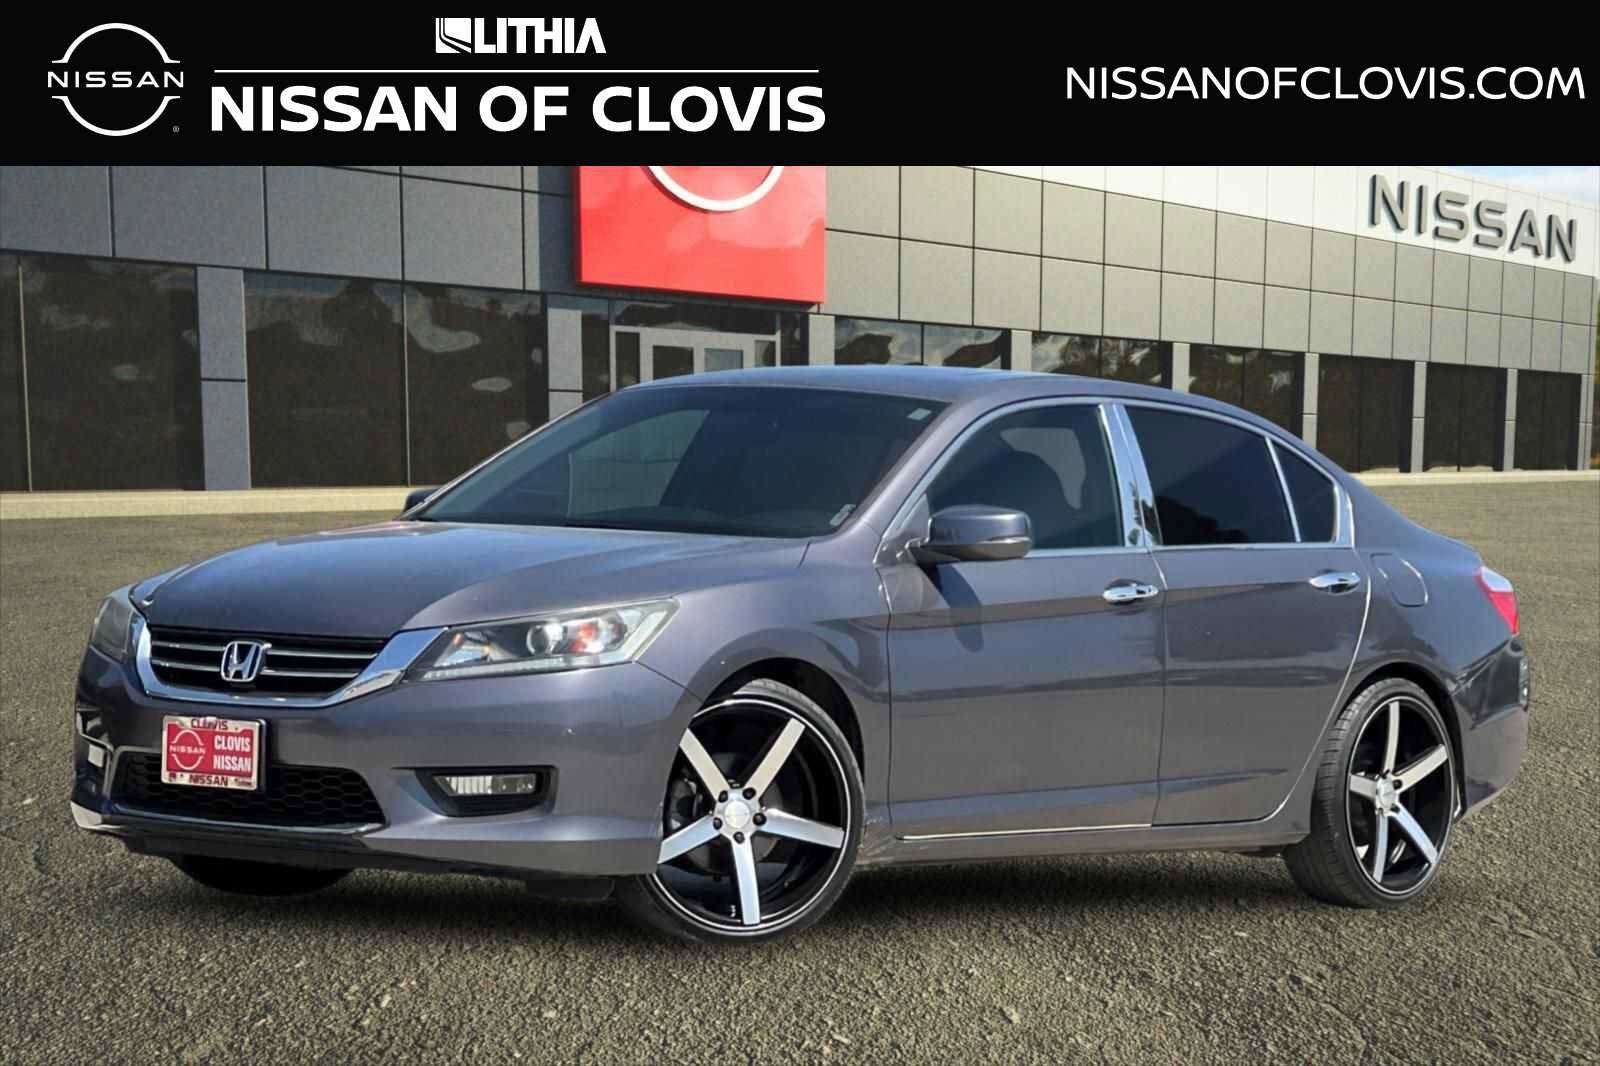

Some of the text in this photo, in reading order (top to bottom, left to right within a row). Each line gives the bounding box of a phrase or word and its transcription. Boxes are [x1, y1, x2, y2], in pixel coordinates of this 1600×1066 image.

[1368, 174, 1577, 263] NISSAN
[169, 744, 206, 754] NISSAN
[214, 735, 251, 752] CLOVIS
[213, 755, 252, 772] NISSAN
[188, 773, 229, 786] NISSAN
